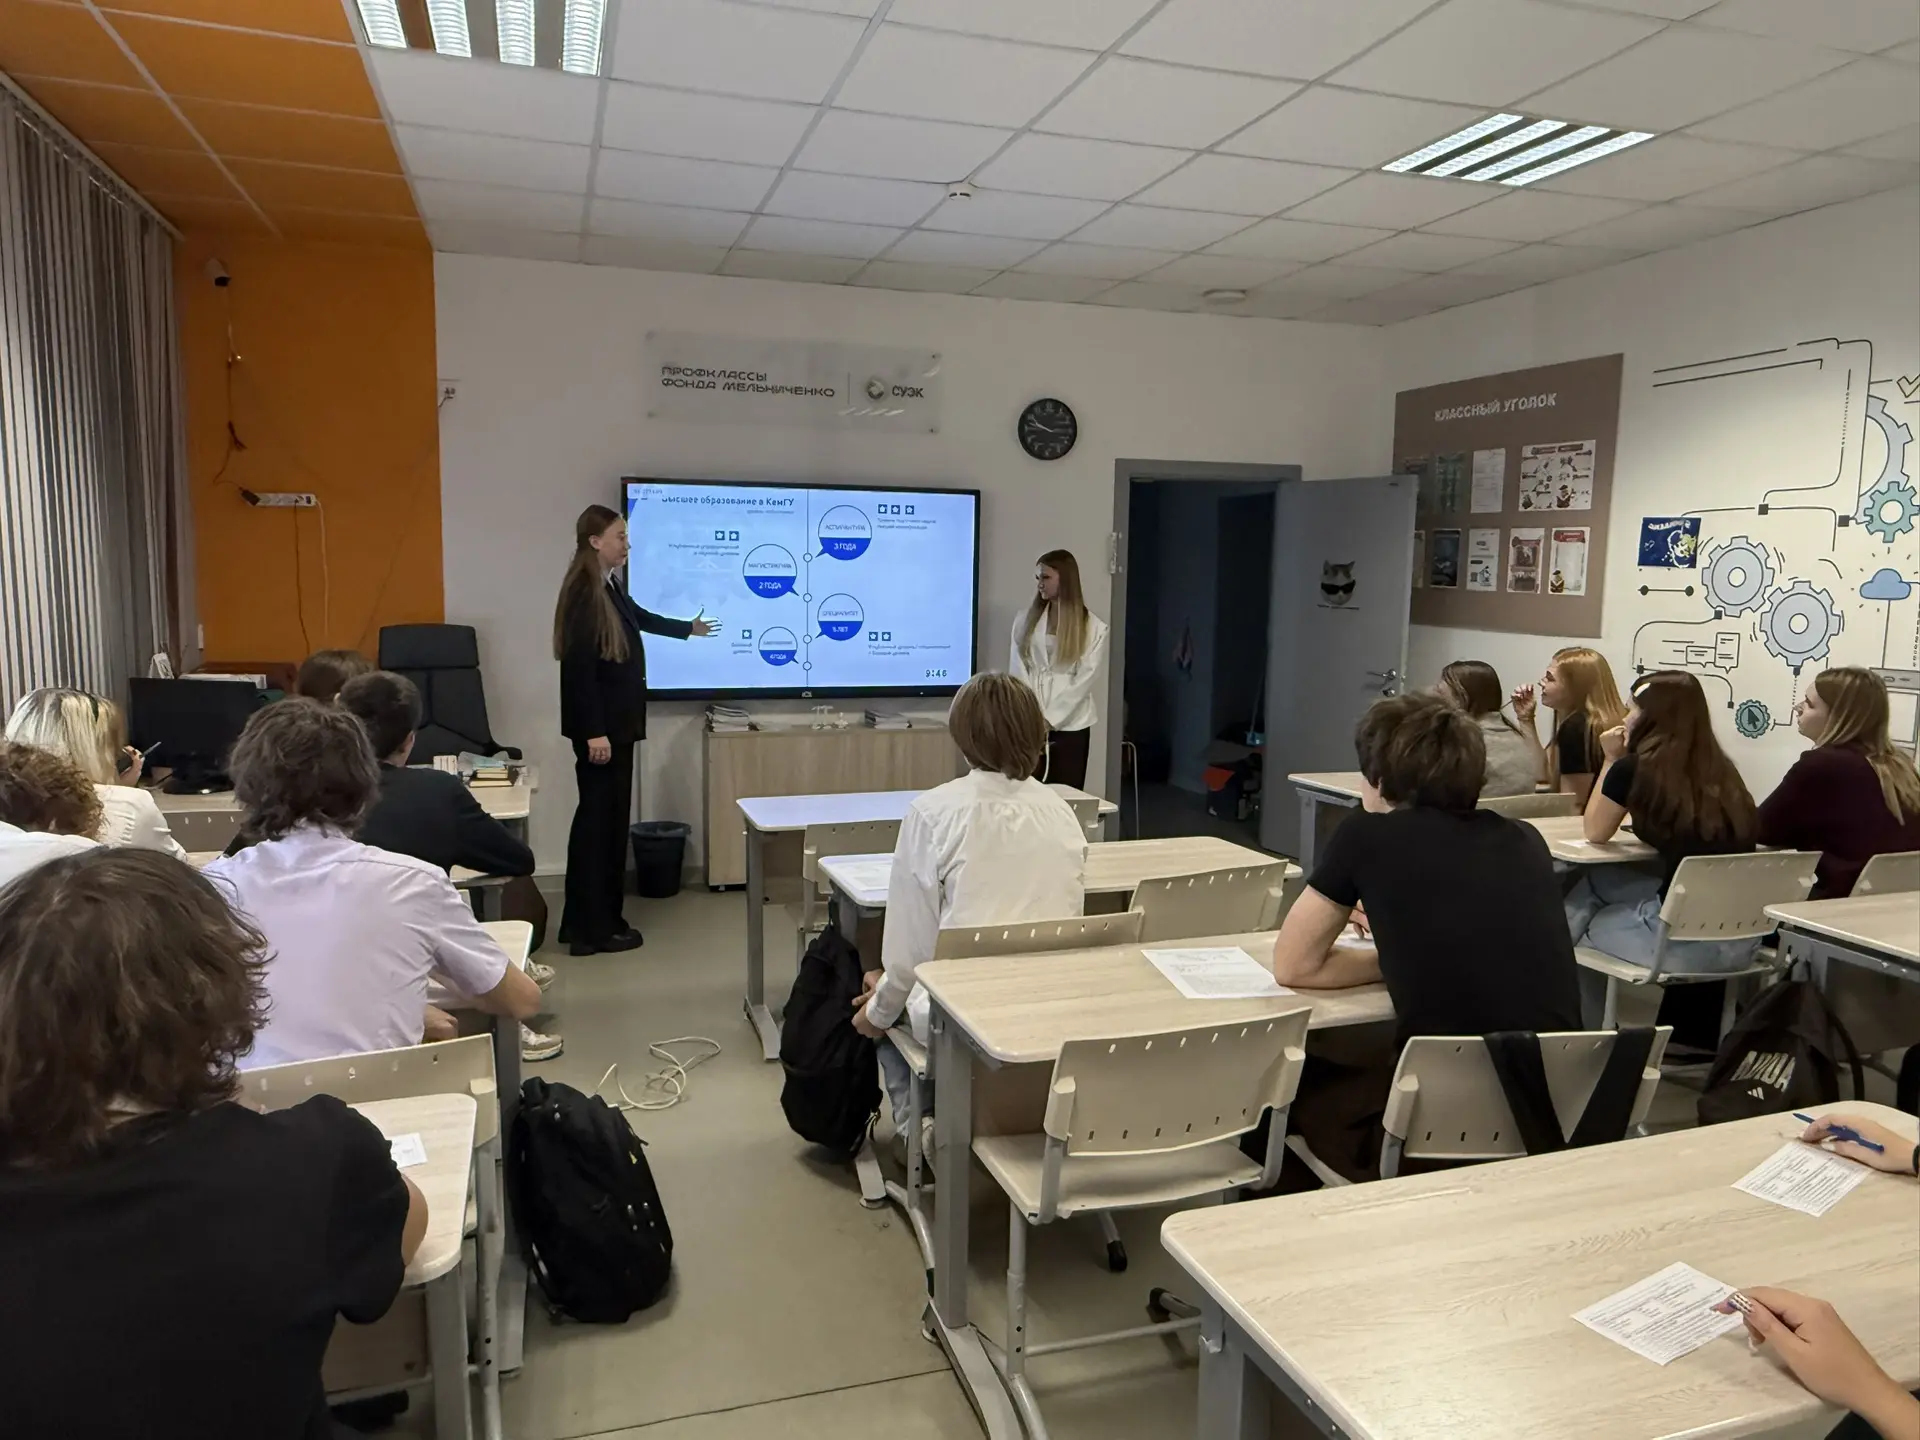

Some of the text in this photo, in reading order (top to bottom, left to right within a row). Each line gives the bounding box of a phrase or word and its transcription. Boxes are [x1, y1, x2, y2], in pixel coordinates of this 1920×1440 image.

[661, 366, 767, 382] ПРОФКЛАССЫ
[661, 378, 836, 398] ФОНДА МЕЛЬНИЧЕНКО
[891, 385, 925, 399] СУЭК
[1434, 392, 1558, 421] КЛАССНЫЙ УГОЛОК
[700, 495, 757, 506] образование
[766, 497, 795, 507] КемГУ
[839, 543, 857, 551] ГОДА
[764, 582, 782, 590] ГОДА
